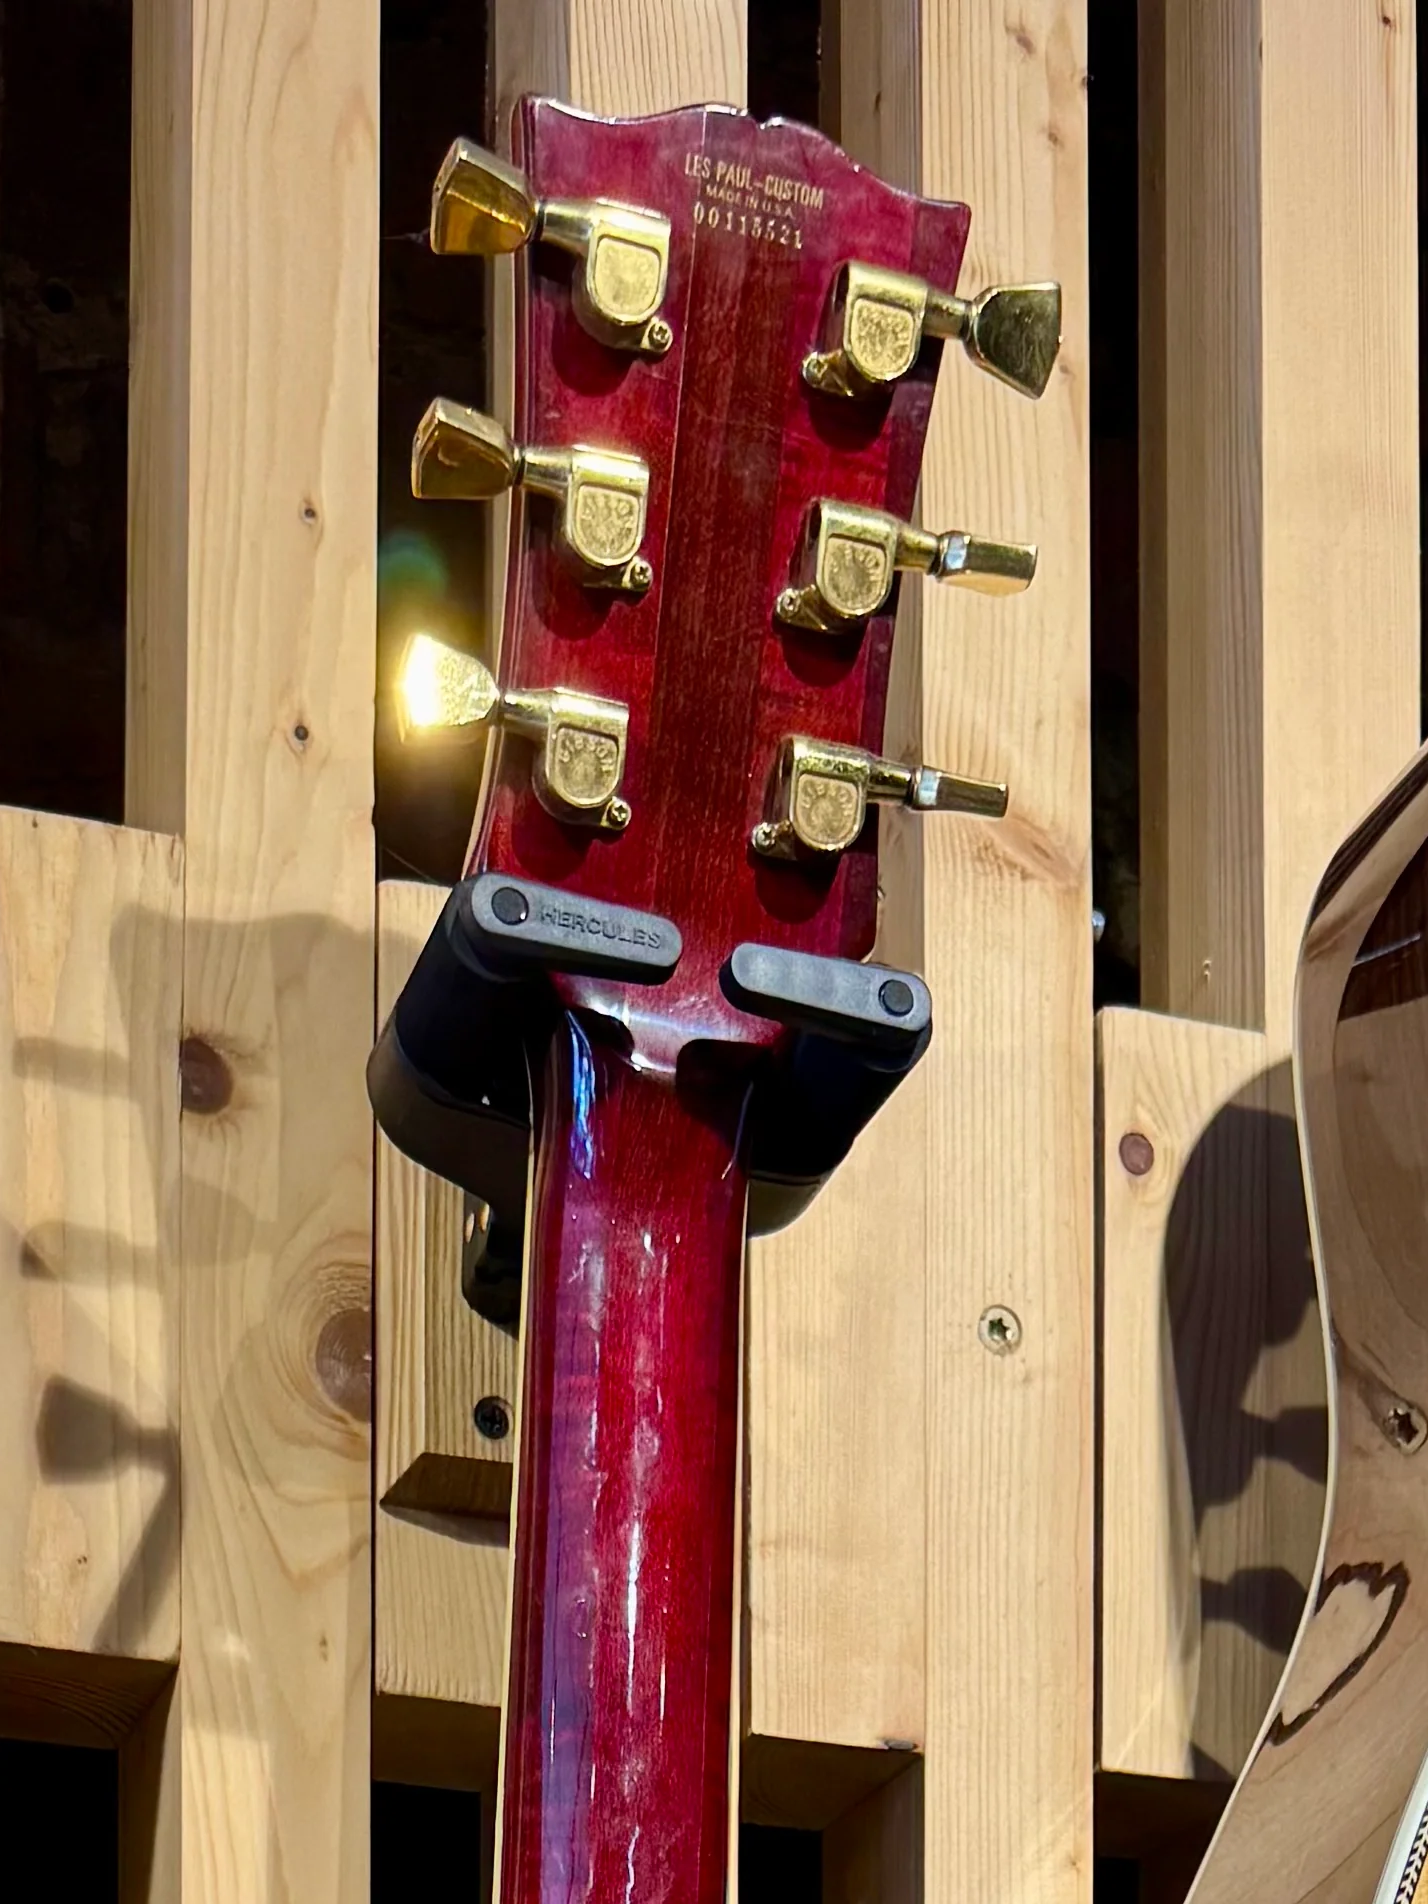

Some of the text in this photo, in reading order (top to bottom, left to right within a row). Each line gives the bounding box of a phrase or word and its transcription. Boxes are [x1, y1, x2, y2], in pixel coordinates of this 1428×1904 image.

[685, 152, 711, 179] LES
[706, 184, 742, 207] MADE
[745, 195, 759, 210] IN
[539, 907, 662, 950] HERCULES
